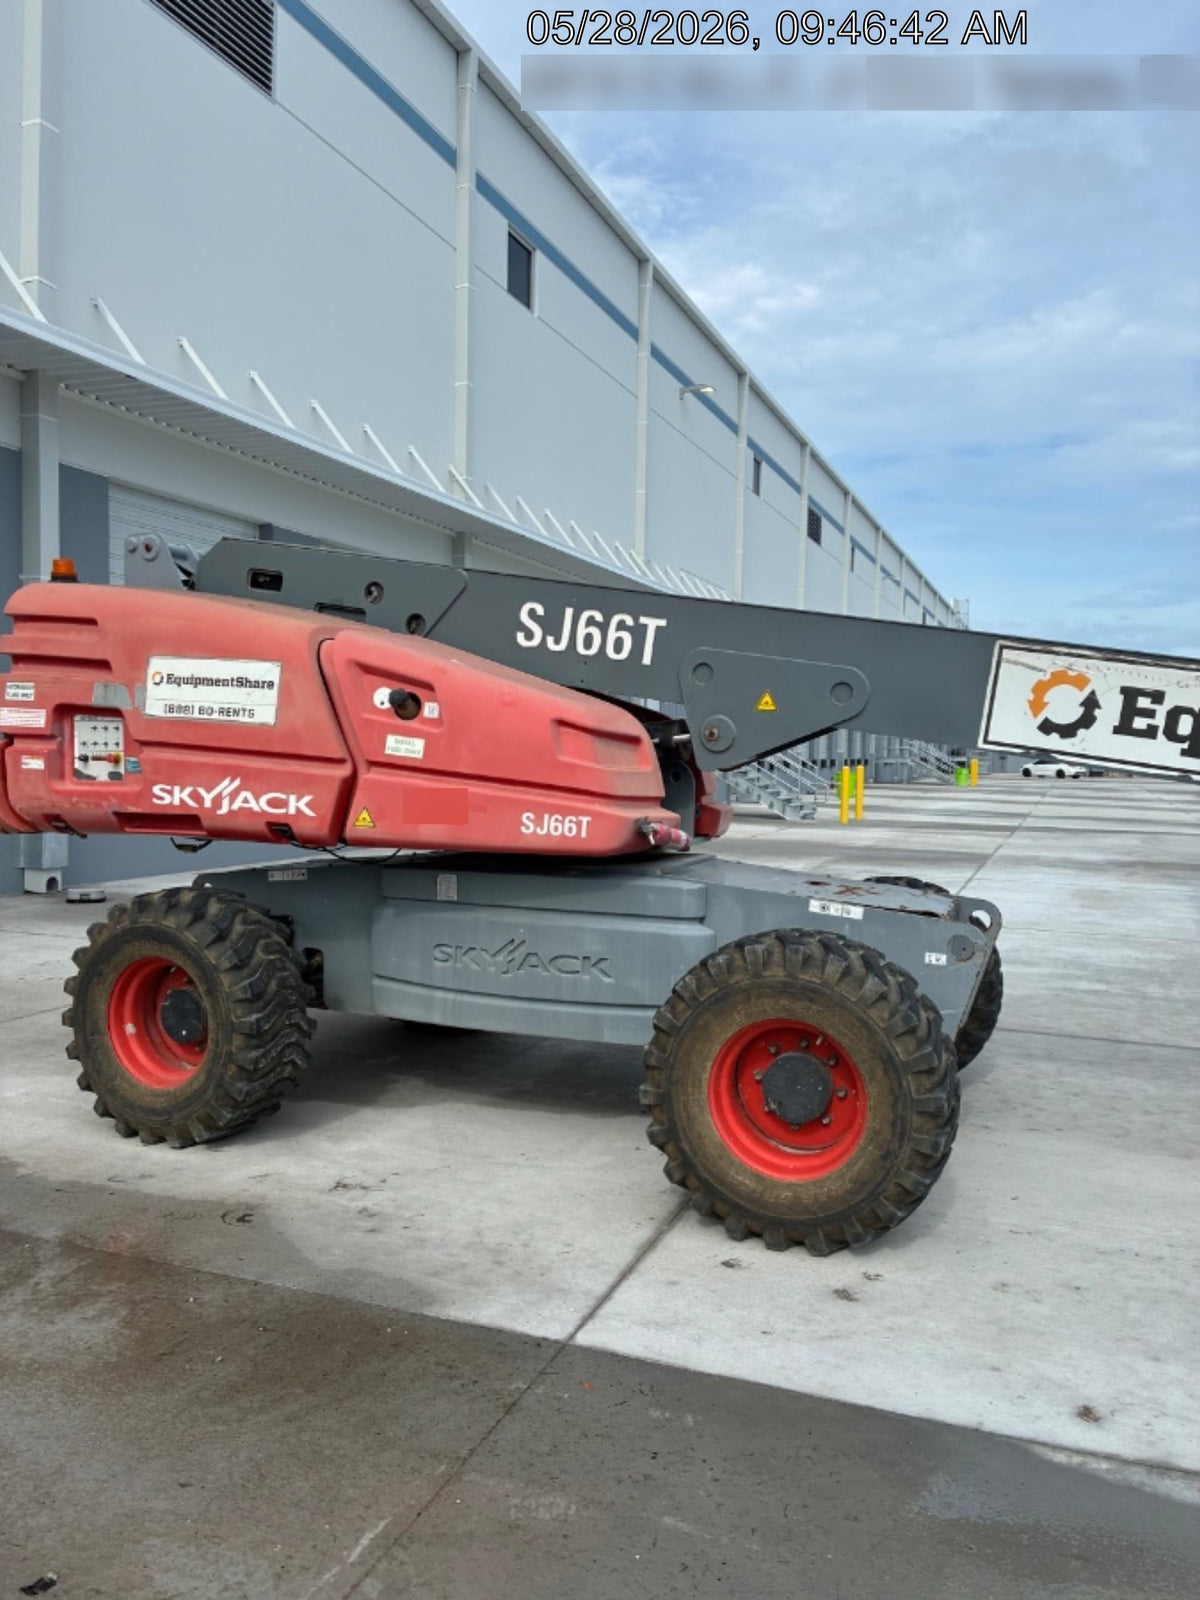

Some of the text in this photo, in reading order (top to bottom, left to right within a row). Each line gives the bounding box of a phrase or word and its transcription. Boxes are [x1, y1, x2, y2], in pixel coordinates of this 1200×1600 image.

[516, 601, 668, 666] SJ66T
[166, 673, 275, 690] EquipmentShare
[151, 775, 318, 818] SKYJACK
[520, 811, 592, 839] SJ66T
[432, 937, 615, 984] SKYJACK
